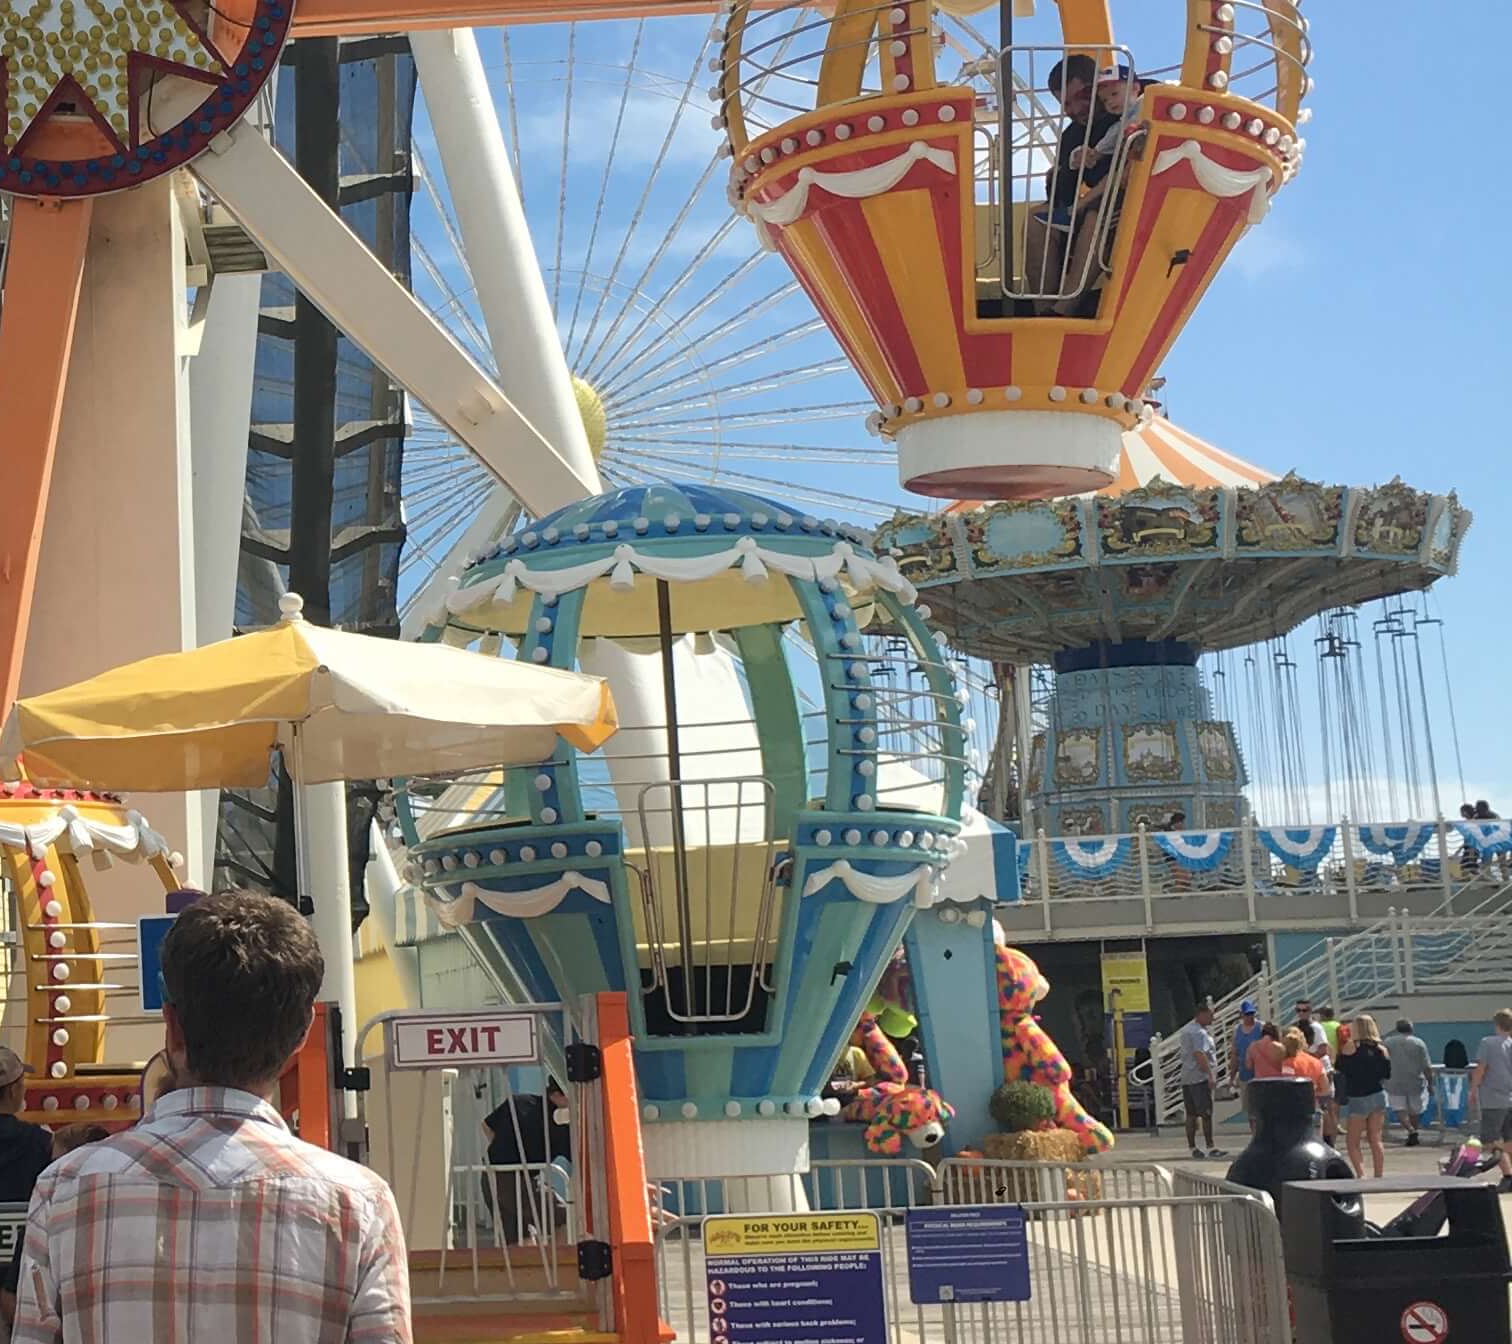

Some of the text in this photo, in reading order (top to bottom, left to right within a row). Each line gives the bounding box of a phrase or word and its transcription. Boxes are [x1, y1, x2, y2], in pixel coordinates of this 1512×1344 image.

[427, 1026, 501, 1055] EXIT
[744, 1224, 769, 1233] FOR
[773, 1222, 807, 1232] YOUR
